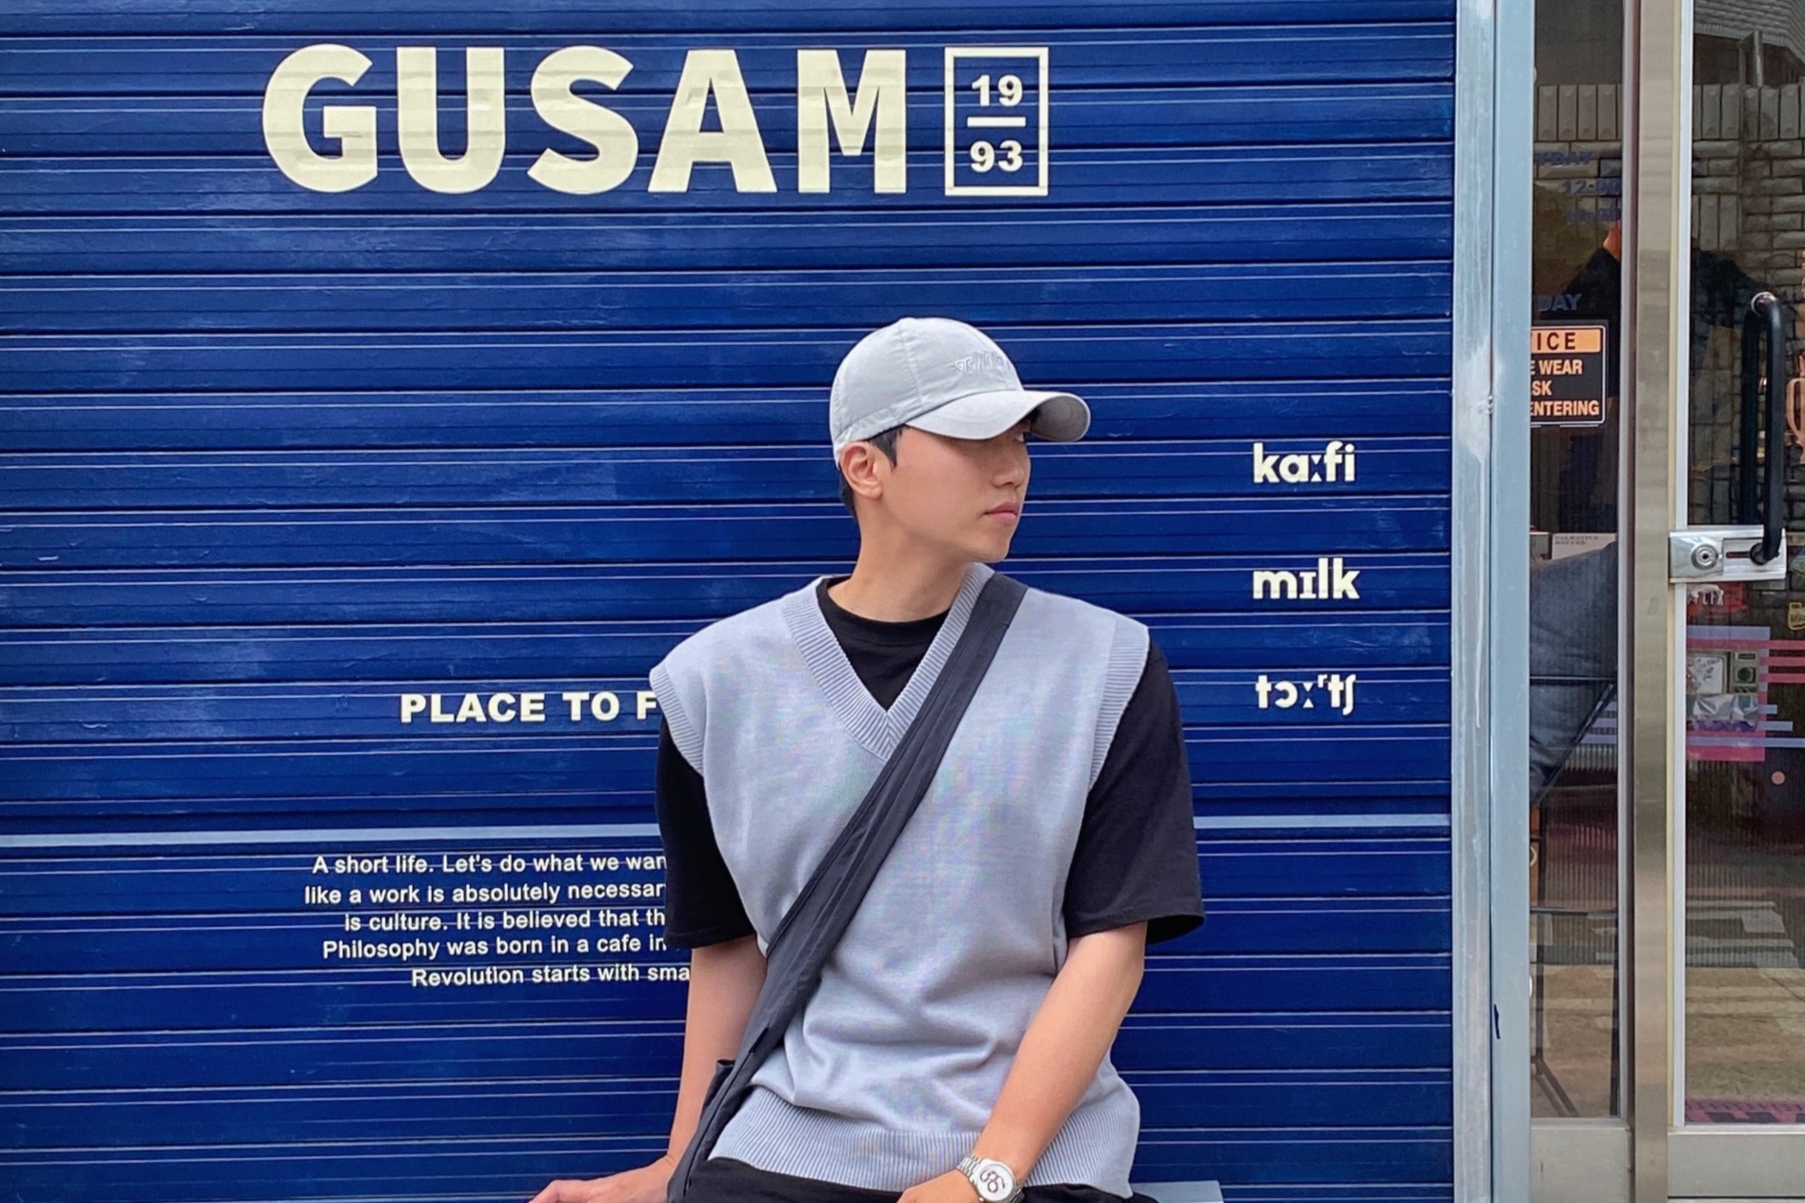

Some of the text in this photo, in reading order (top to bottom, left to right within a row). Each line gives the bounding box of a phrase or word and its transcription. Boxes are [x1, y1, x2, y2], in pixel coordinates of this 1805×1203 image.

[971, 74, 1023, 107] 19
[262, 43, 906, 195] GUSAM
[970, 140, 1023, 173] 93
[1532, 332, 1576, 351] ICE
[1538, 359, 1583, 375] WEAR
[401, 693, 546, 723] PLACE
[562, 691, 620, 721] TO
[312, 856, 329, 874] A
[334, 855, 389, 874] short
[395, 854, 434, 873] life.
[442, 854, 493, 873] Let's
[500, 854, 526, 872] do
[533, 853, 584, 871] what
[590, 855, 619, 870] we
[304, 886, 342, 904] like
[349, 889, 362, 903] a
[369, 885, 420, 903] work
[427, 884, 445, 902] is
[452, 882, 560, 904] absolutely
[344, 914, 362, 931] is
[368, 912, 449, 930] culture.
[456, 912, 471, 930] It
[478, 911, 496, 929] is
[502, 910, 591, 929] believed
[598, 909, 639, 926] that
[323, 938, 440, 961] Philosophy
[446, 941, 489, 956] was
[496, 936, 543, 955] born
[550, 935, 570, 953] in
[576, 939, 590, 953] a
[596, 934, 642, 952] cafe
[411, 967, 524, 987] Revolution
[531, 964, 591, 983] starts
[597, 963, 640, 981] with
